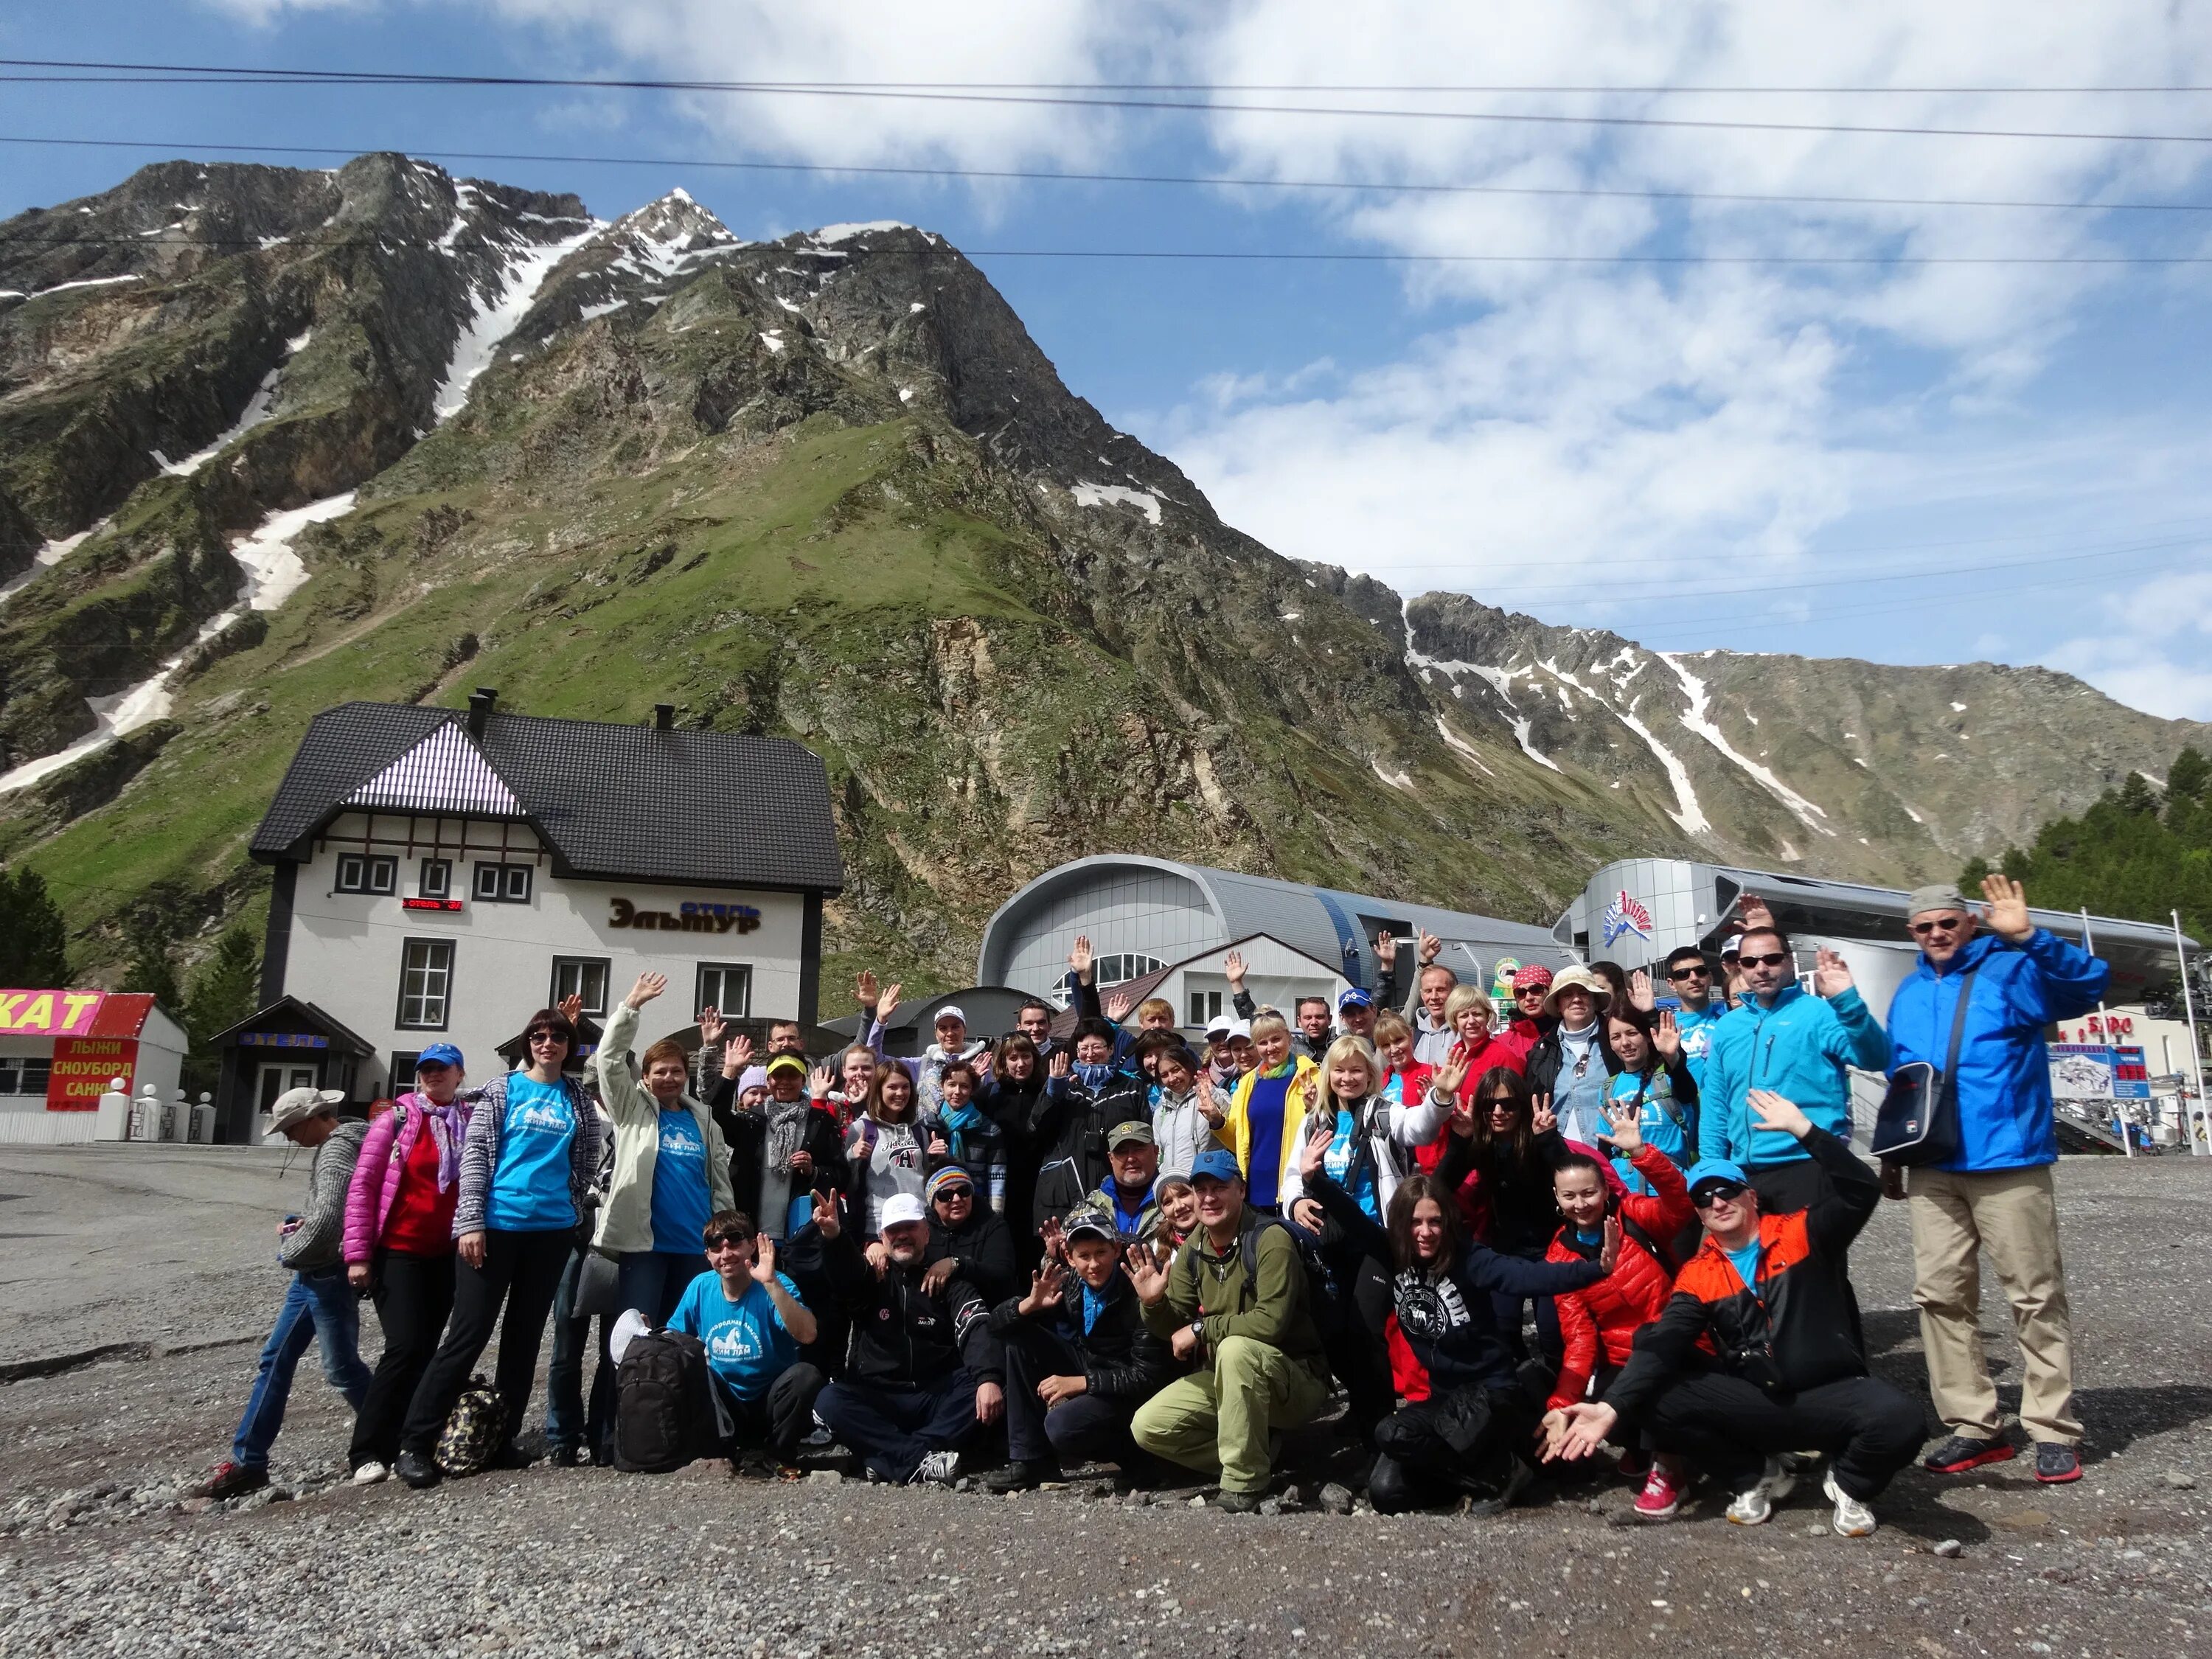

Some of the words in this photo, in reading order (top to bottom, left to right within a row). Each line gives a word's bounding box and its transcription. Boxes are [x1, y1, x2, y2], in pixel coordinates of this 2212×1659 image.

[2088, 1016, 2132, 1034] БРС
[70, 1040, 122, 1055] ЛЫЖИ
[240, 1032, 328, 1048] ОТЕЛЬ
[53, 1061, 132, 1077] СНОУБОРД
[524, 1117, 546, 1127] ЖИМ
[548, 1121, 567, 1131] ЛАМ
[684, 1144, 700, 1152] ЛАМ
[733, 1347, 751, 1356] ЛАМ
